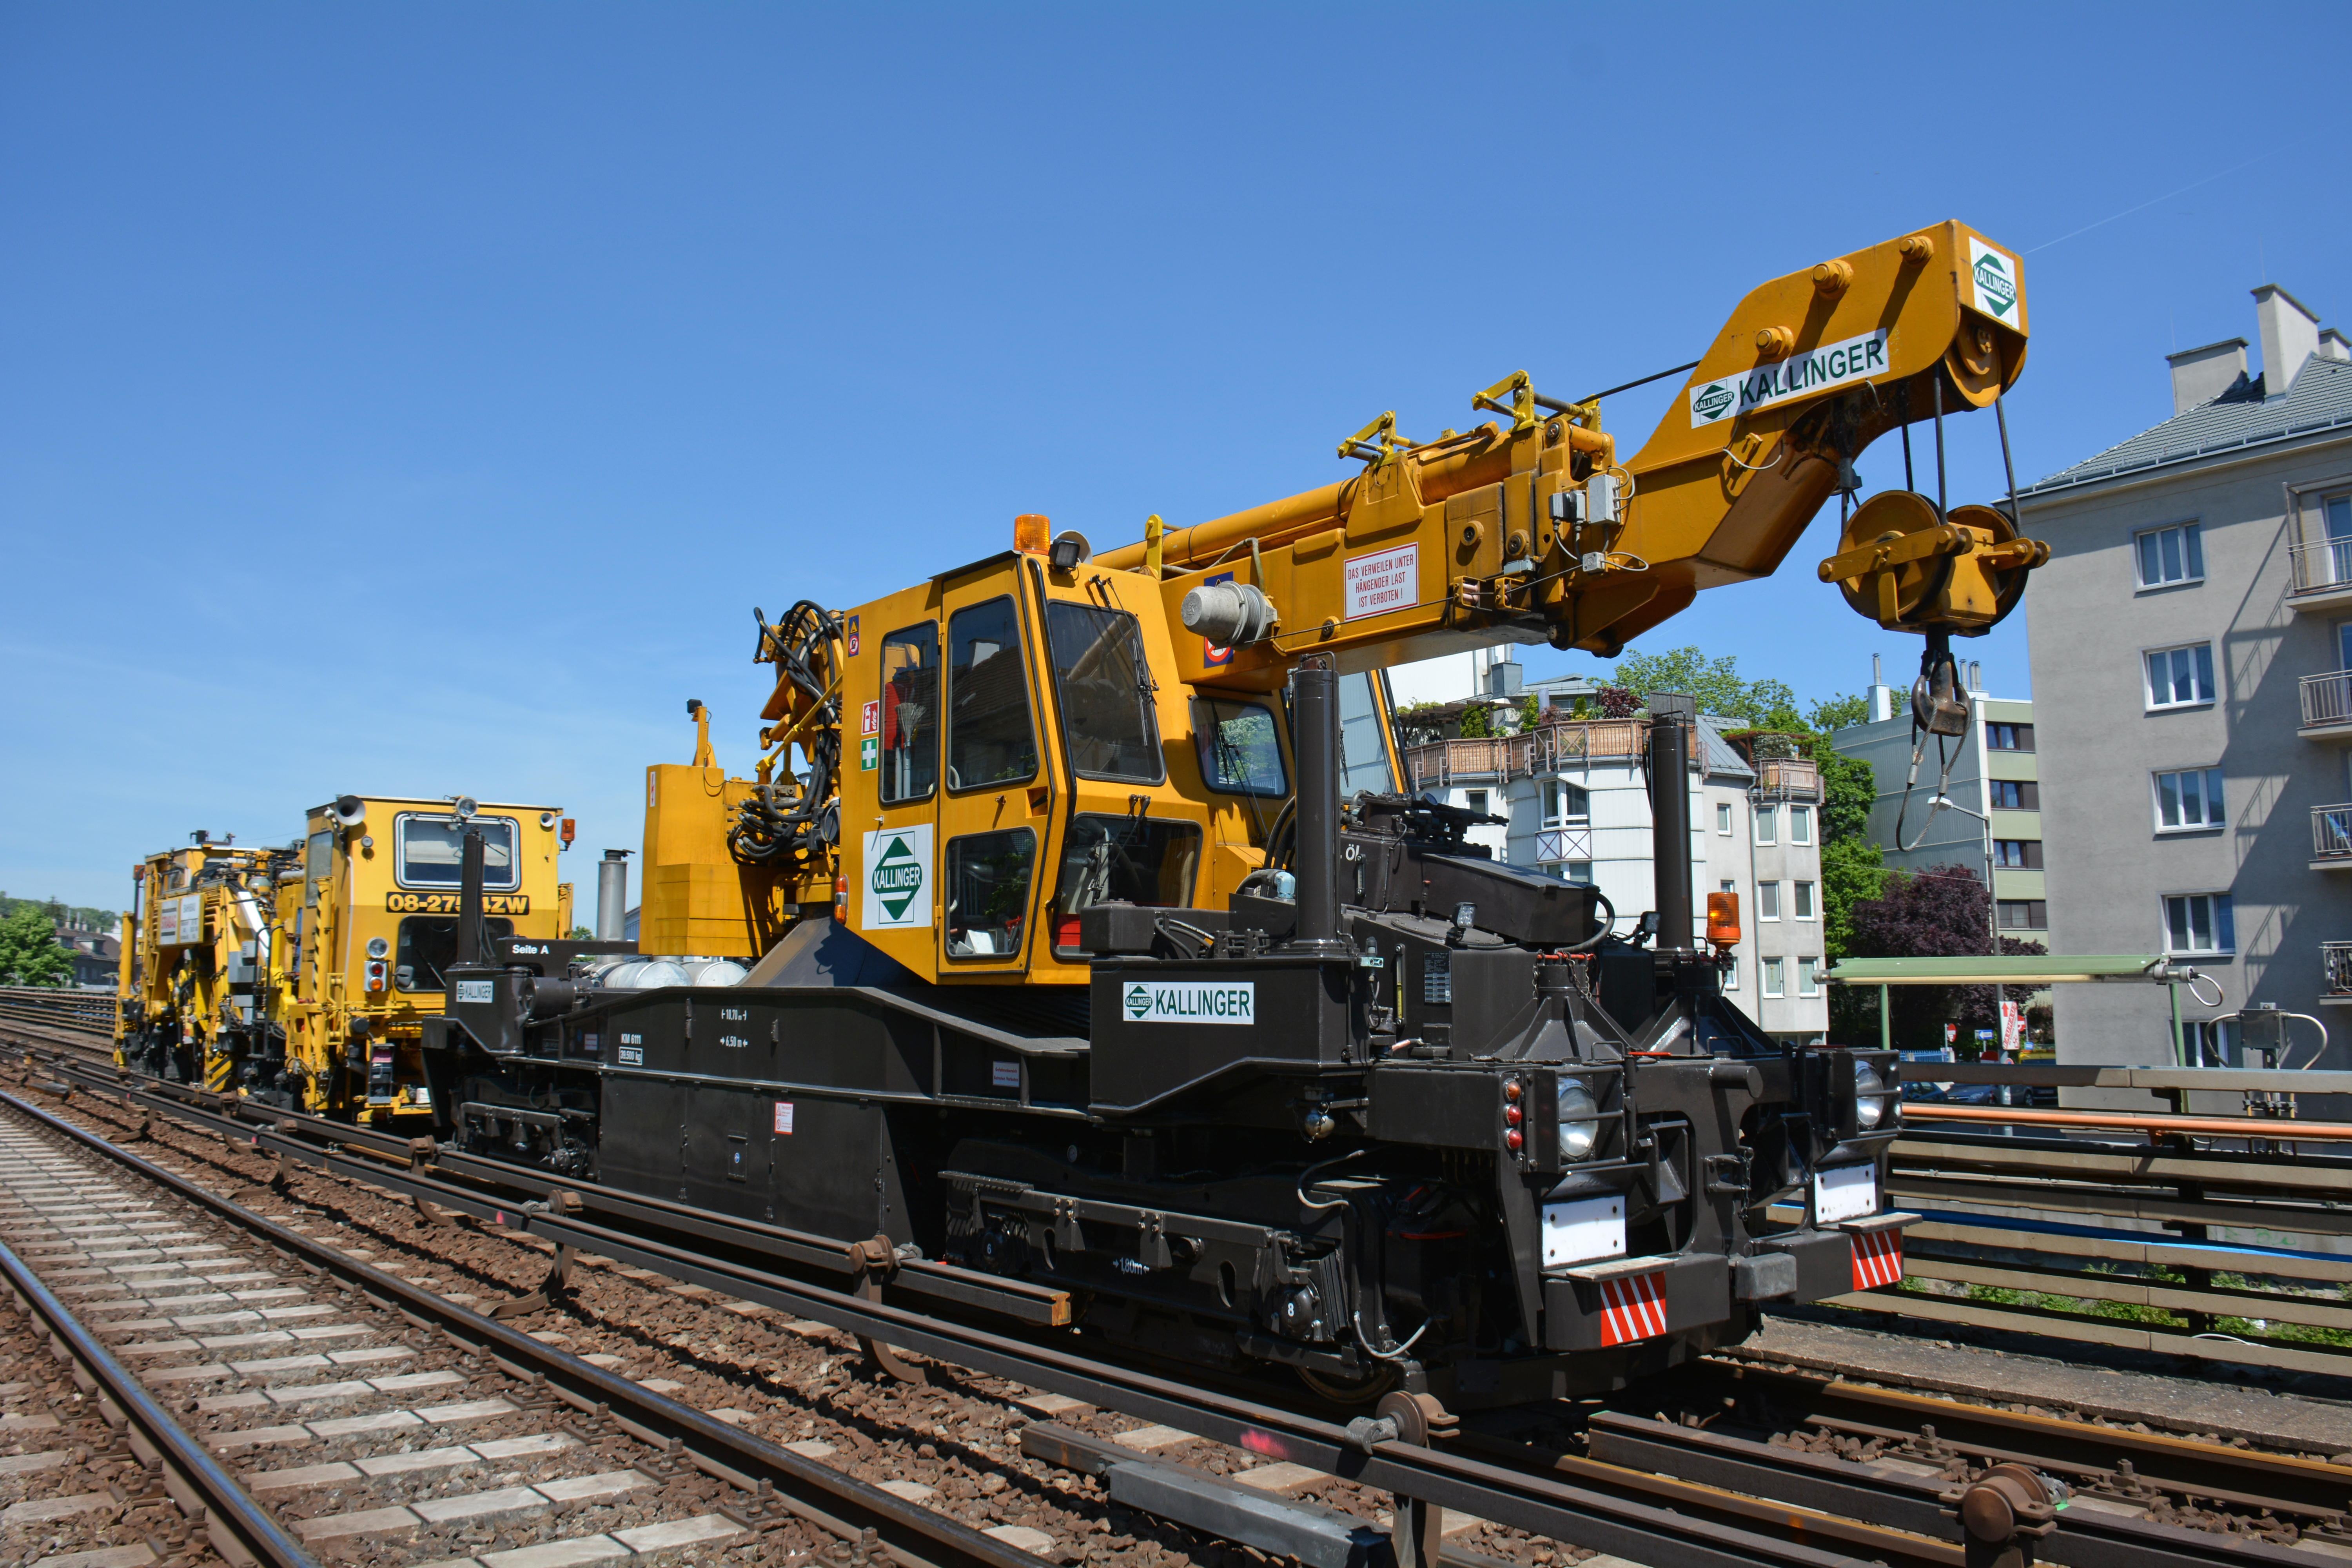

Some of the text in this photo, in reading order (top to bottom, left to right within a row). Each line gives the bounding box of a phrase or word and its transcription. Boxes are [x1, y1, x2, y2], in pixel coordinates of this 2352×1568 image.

[1974, 265, 2015, 301] KALLINGER
[1739, 339, 1884, 407] KALLINGER
[1694, 392, 1733, 412] KALLINGER
[1348, 554, 1414, 580] DAS VERWEILEN UNTER
[1356, 572, 1406, 593] HÄNGENDER LAST
[1359, 596, 1368, 608] IST
[1370, 588, 1398, 605] VERBOTEN
[1345, 844, 1360, 862] Öl
[873, 866, 921, 889] KALLINGER
[512, 944, 549, 954] Seite A
[465, 985, 492, 999] KALLINGER
[1126, 997, 1152, 1006] KALLINGER
[1156, 989, 1250, 1016] KALLINGER
[621, 1033, 641, 1045] KM 6111
[726, 1036, 742, 1048] 6,50 m
[635, 1051, 641, 1063] kg
[987, 1243, 991, 1254] 6
[1288, 1303, 1294, 1317] 8
